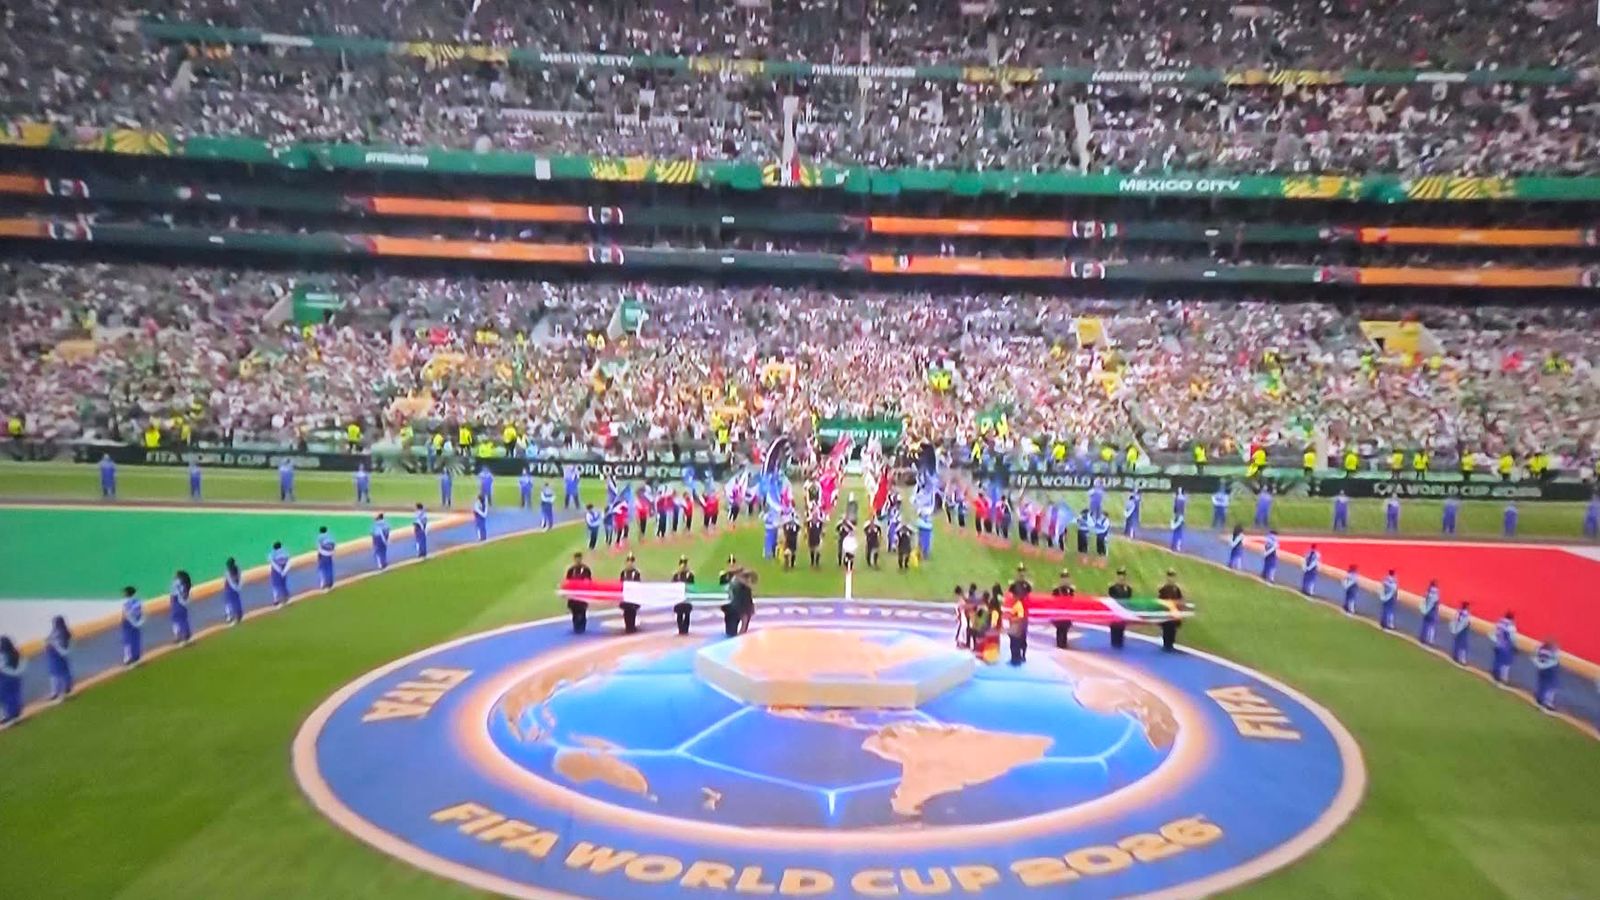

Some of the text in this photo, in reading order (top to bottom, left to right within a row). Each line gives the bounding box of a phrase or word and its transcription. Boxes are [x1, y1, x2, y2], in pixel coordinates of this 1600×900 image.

[1119, 179, 1240, 192] MEXICO CITY
[145, 452, 178, 463] FIFA
[180, 452, 235, 465] WORLD
[237, 454, 267, 466] CUP
[528, 462, 559, 474] FIFA
[614, 464, 642, 476] CUP
[1040, 475, 1091, 488] WORLD
[1406, 484, 1459, 496] WORLD
[362, 668, 474, 722] FIFA
[1204, 686, 1301, 740] FIFA
[430, 801, 1224, 896] FIFA WORLD CUP 2026
